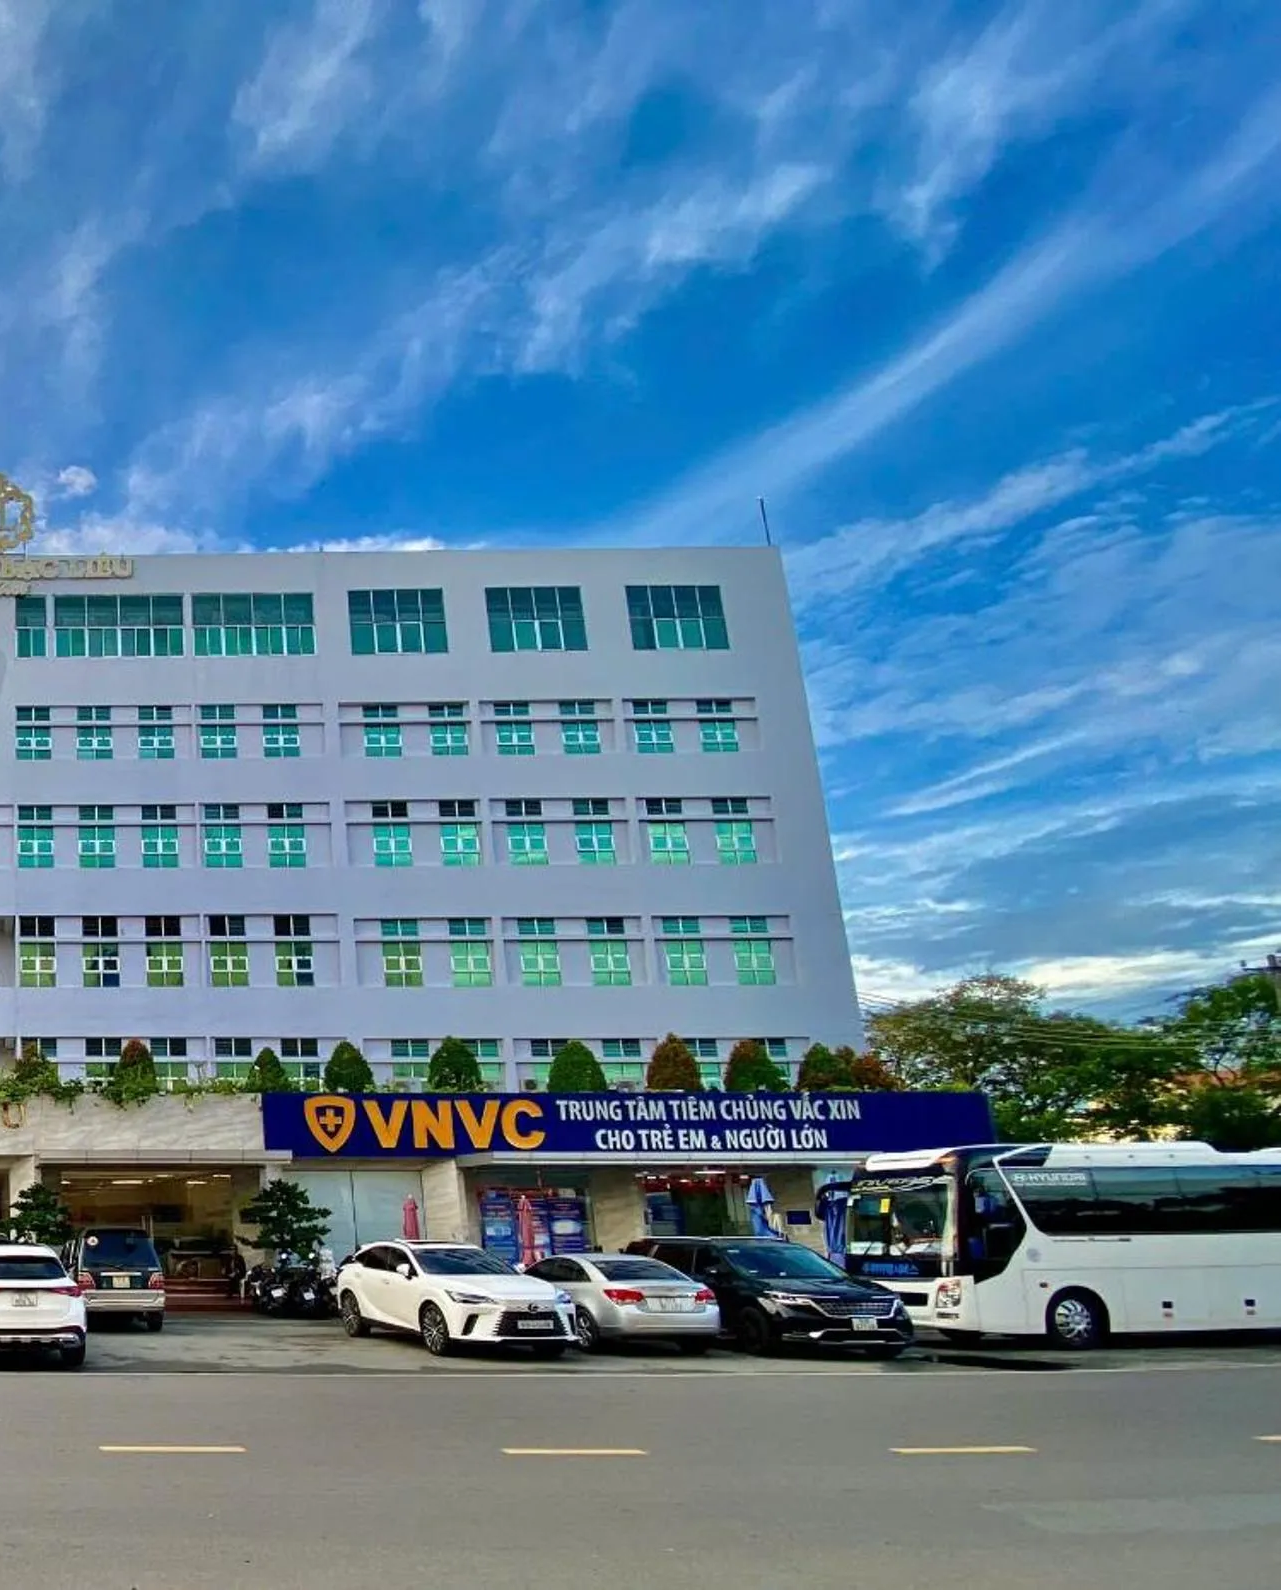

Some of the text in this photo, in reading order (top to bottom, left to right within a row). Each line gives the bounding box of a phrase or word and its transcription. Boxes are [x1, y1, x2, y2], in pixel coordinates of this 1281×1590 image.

[556, 1100, 623, 1121] TRUNG
[625, 1096, 668, 1121] TÂM
[669, 1096, 717, 1121] TIÊM
[720, 1094, 787, 1121] CHỦNG
[827, 1100, 861, 1120] XIN
[362, 1099, 546, 1149] VNVC
[595, 1123, 828, 1149] CHO TRẺ EM & NGƯỜI LỚN
